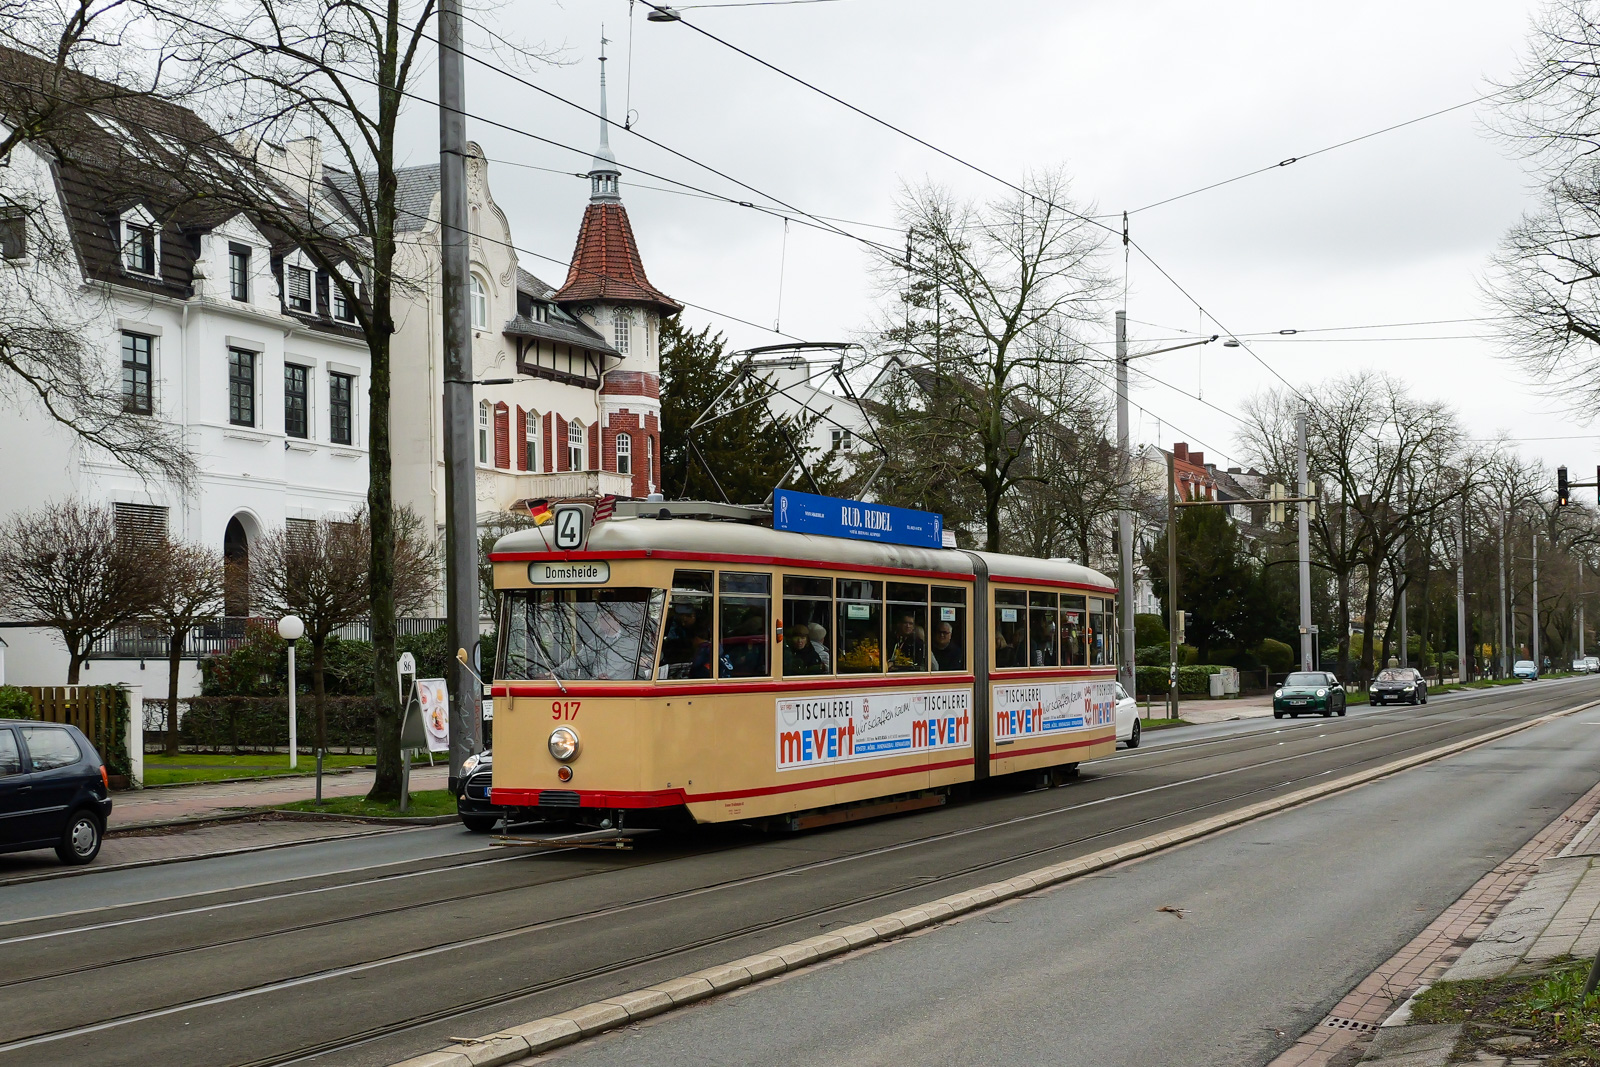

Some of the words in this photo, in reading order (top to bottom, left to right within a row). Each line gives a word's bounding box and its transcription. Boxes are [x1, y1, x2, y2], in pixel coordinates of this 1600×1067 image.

[560, 512, 576, 543] 4
[841, 506, 863, 528] RUD.
[864, 509, 893, 532] REDEL
[545, 565, 598, 579] Domsheide
[403, 660, 412, 672] 86
[924, 694, 968, 711] TISCHLEREI
[1005, 688, 1042, 703] TISCHLEREI
[551, 701, 581, 721] 917
[795, 700, 853, 721] TISCHLEREI
